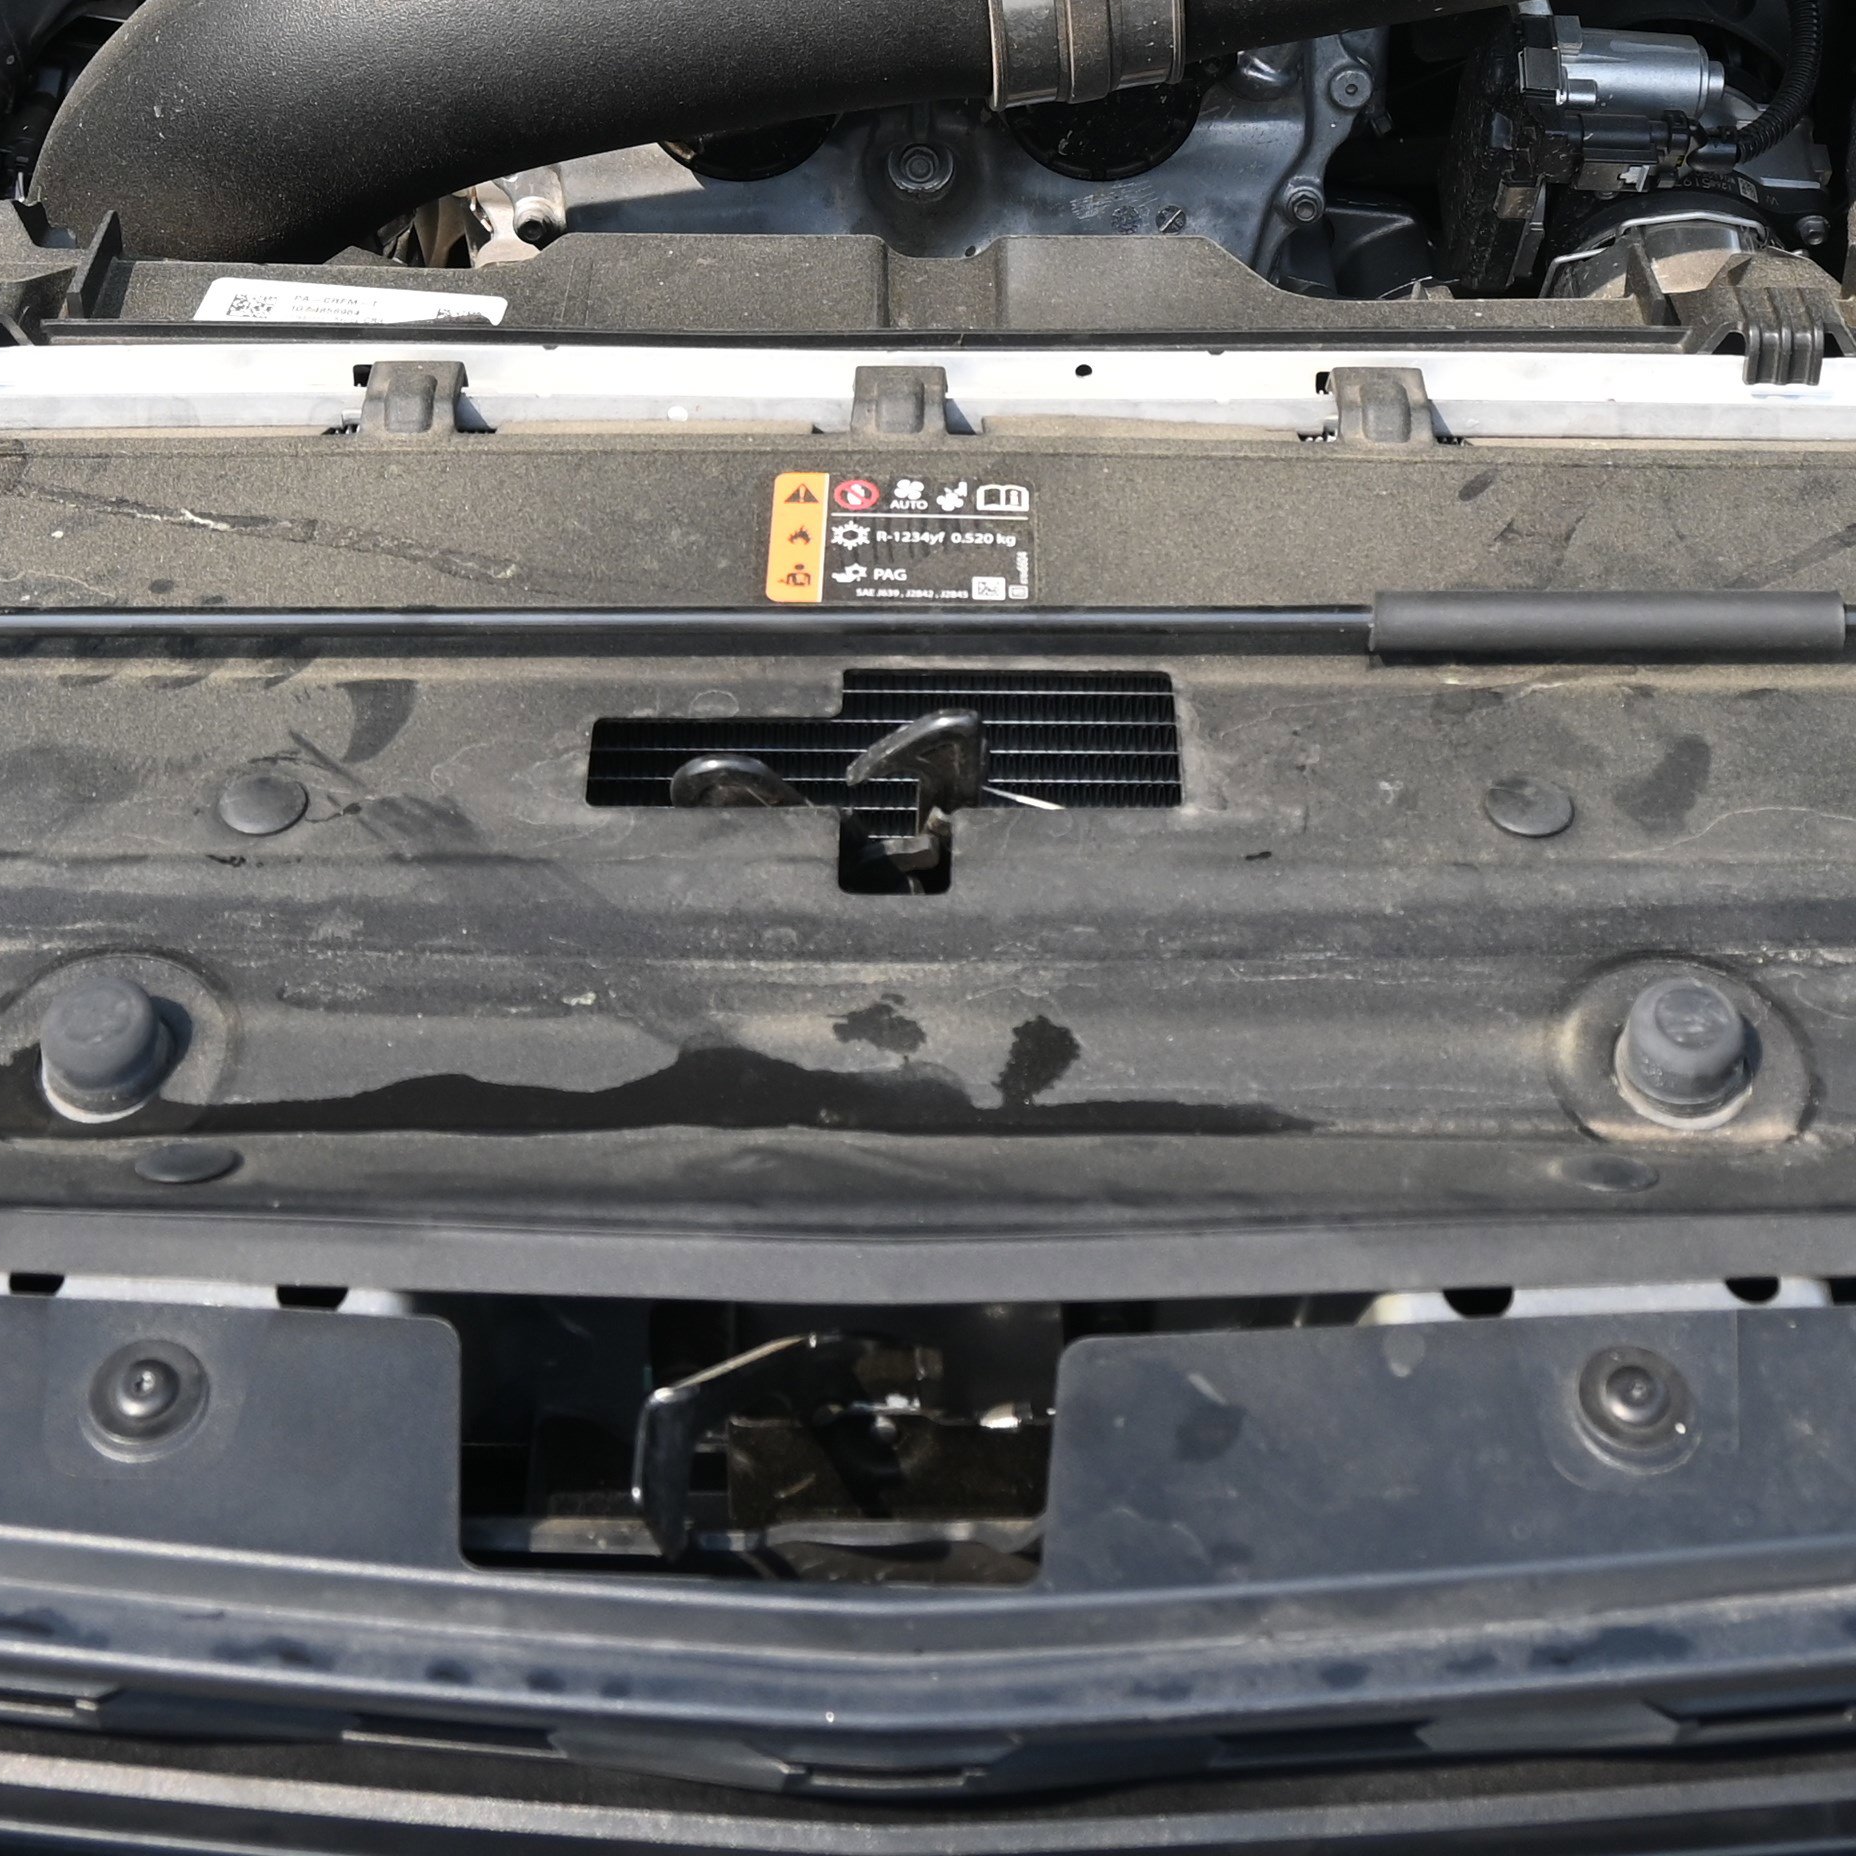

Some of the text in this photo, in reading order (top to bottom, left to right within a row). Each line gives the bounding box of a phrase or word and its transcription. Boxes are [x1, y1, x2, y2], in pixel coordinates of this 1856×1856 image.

[889, 499, 929, 511] AUTO
[876, 530, 1017, 547] R-1234yf 0.520 kg
[873, 568, 908, 581] PAG
